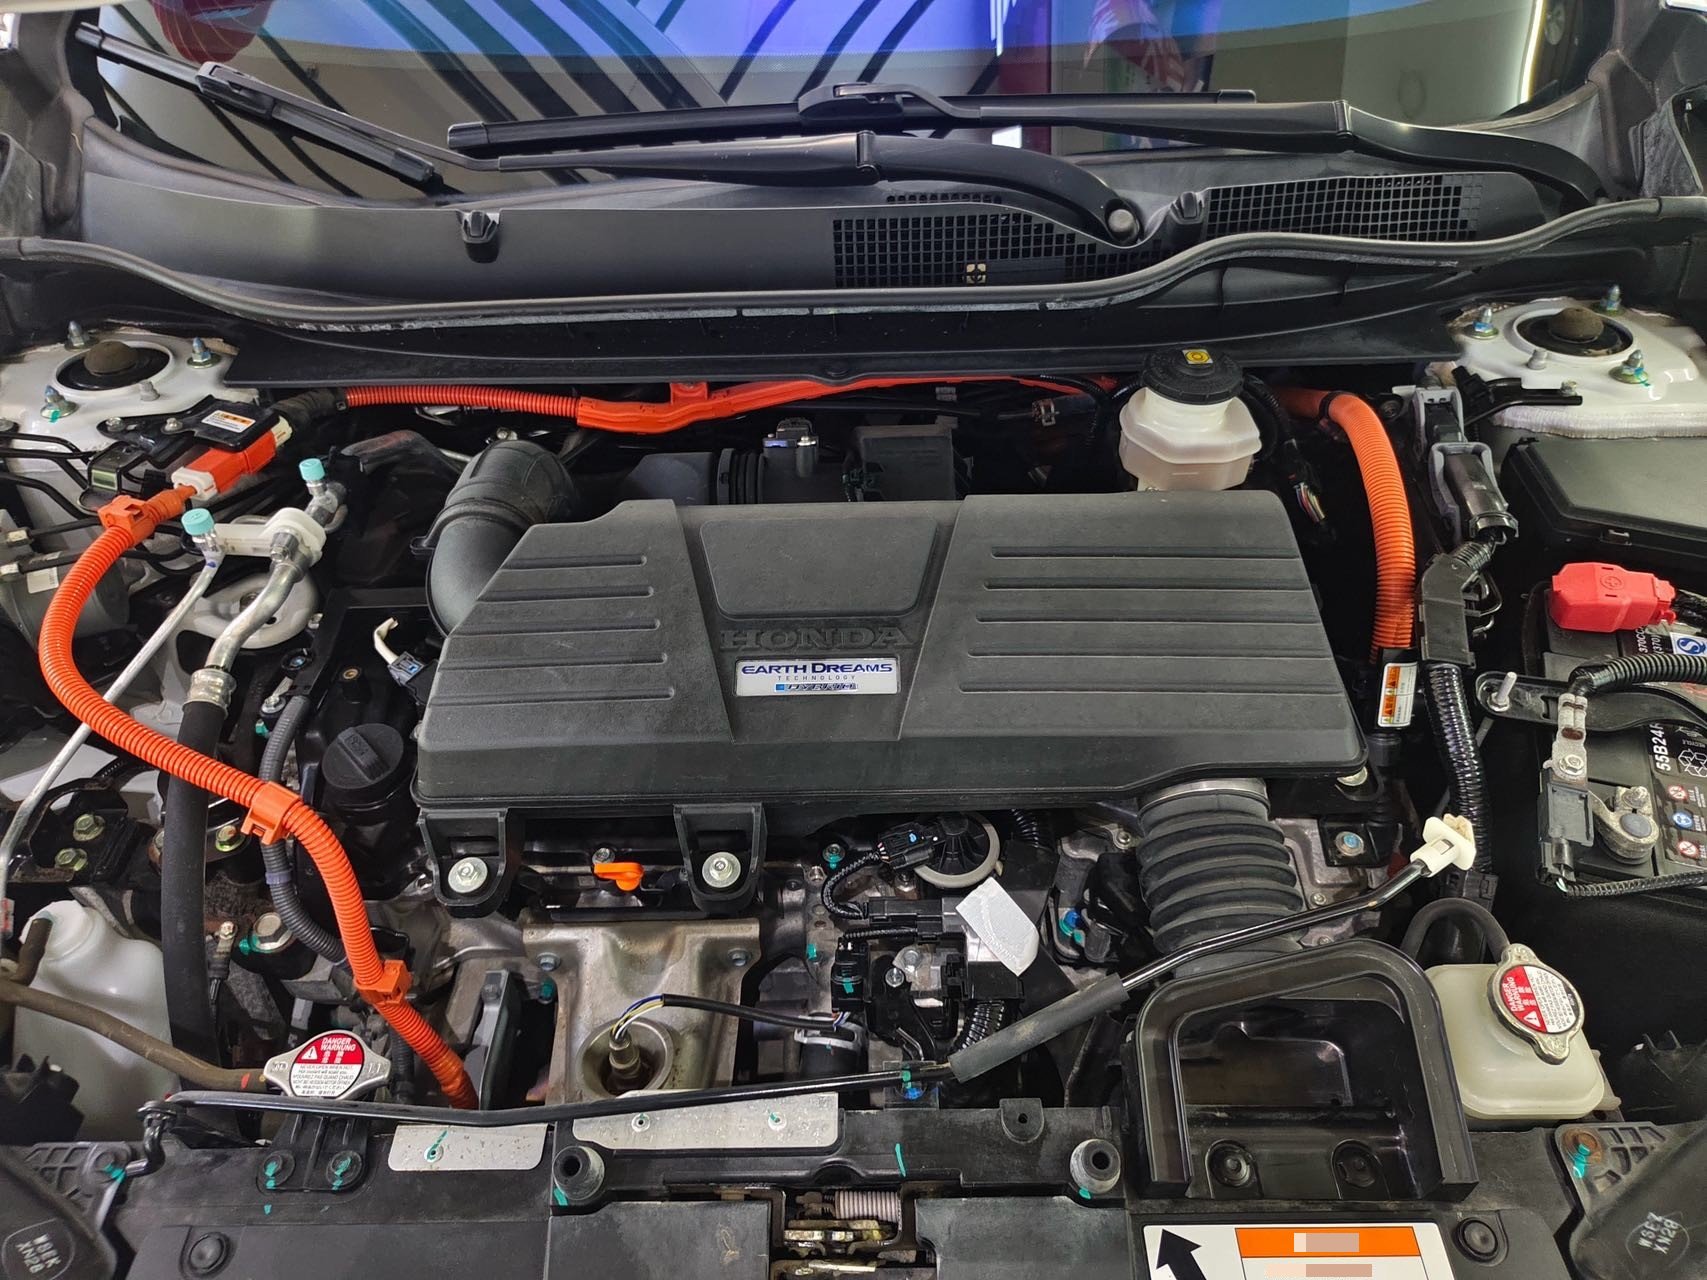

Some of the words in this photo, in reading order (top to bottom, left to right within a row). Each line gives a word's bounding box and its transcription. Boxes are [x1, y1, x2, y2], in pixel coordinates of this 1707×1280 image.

[720, 627, 916, 650] HONDA
[1635, 626, 1648, 653] 370CC
[741, 664, 807, 675] EARTH
[811, 663, 893, 674] DREAMS
[322, 1037, 352, 1045] DANGER
[320, 1044, 356, 1052] WARNUNG
